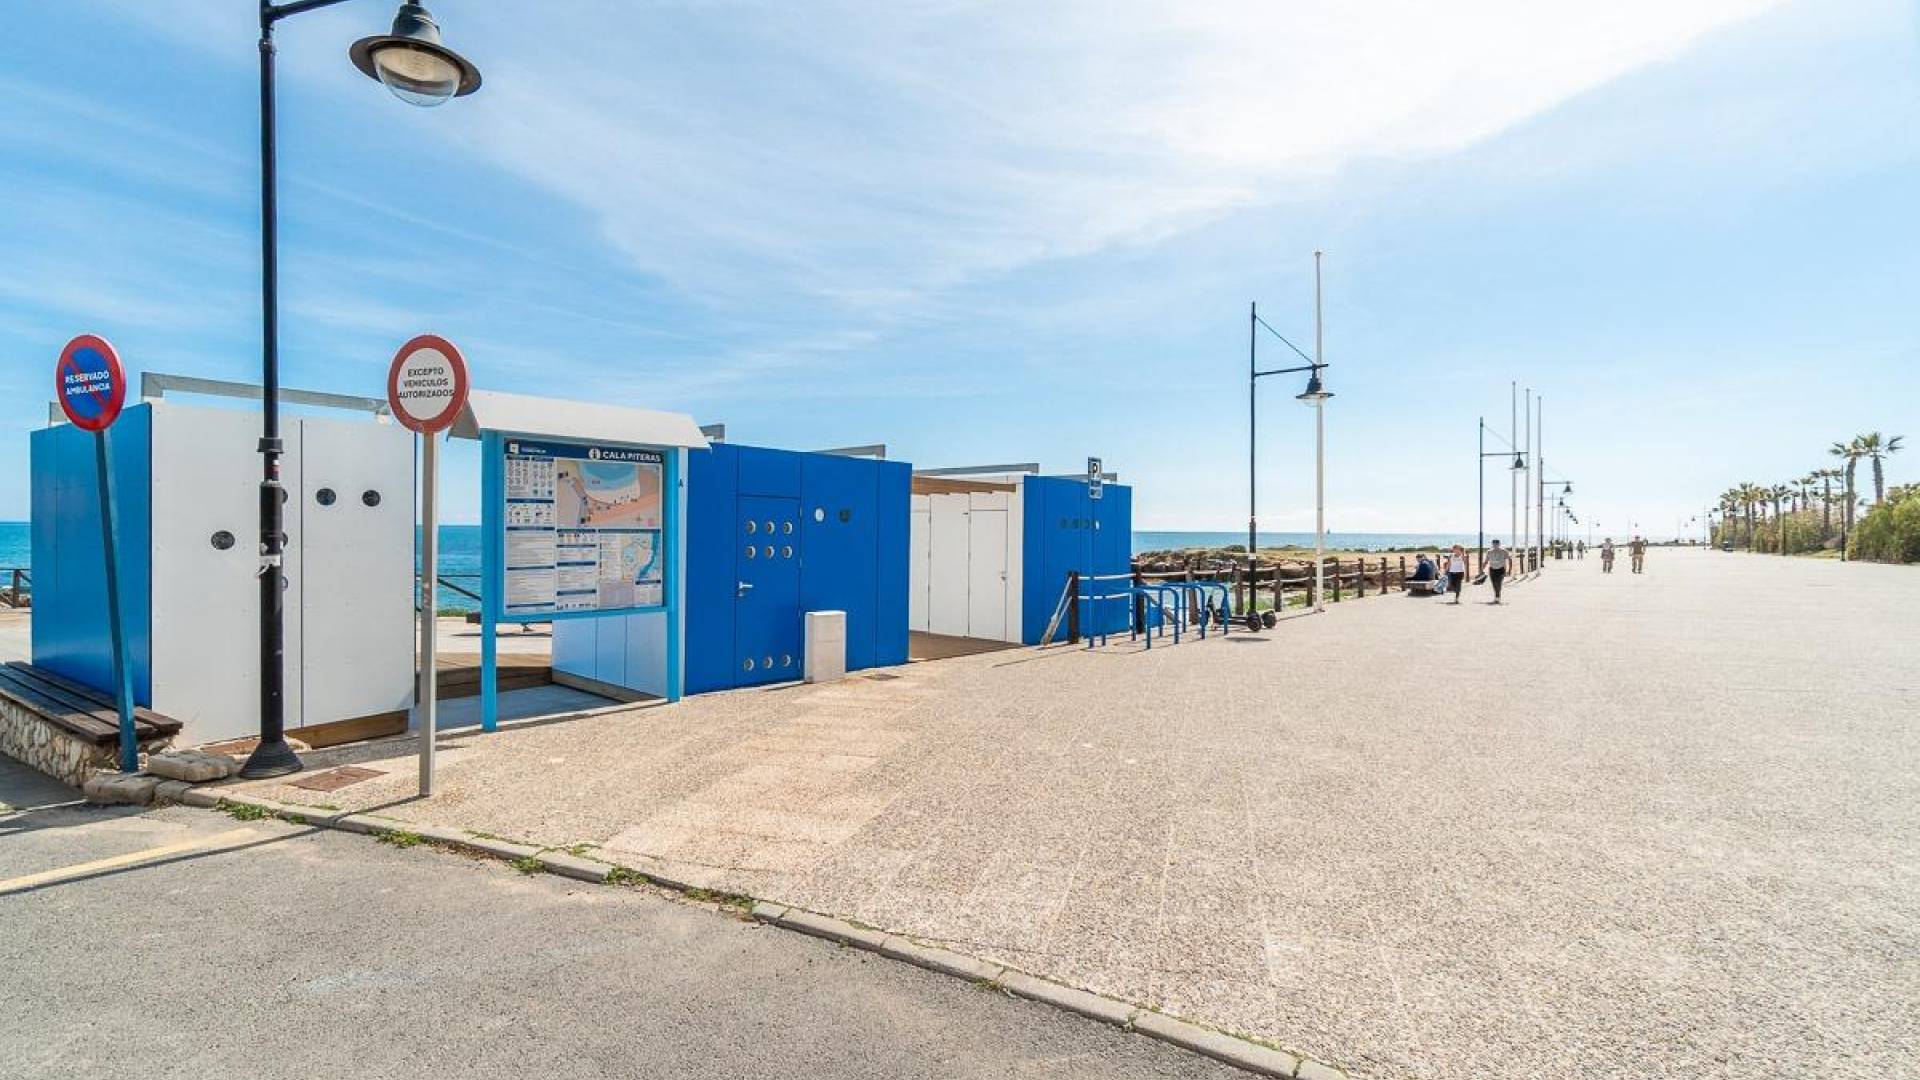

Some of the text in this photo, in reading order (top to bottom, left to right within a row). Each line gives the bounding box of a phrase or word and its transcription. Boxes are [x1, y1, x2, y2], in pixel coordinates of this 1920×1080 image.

[65, 370, 110, 383] RESERVADO
[407, 367, 444, 377] EXCEPTO
[403, 378, 449, 387] VEHICULOS
[66, 382, 110, 395] AMBULANCIA
[399, 389, 455, 399] AUTORIZADOS
[602, 451, 626, 460] CALA
[627, 453, 661, 463] PITERAS
